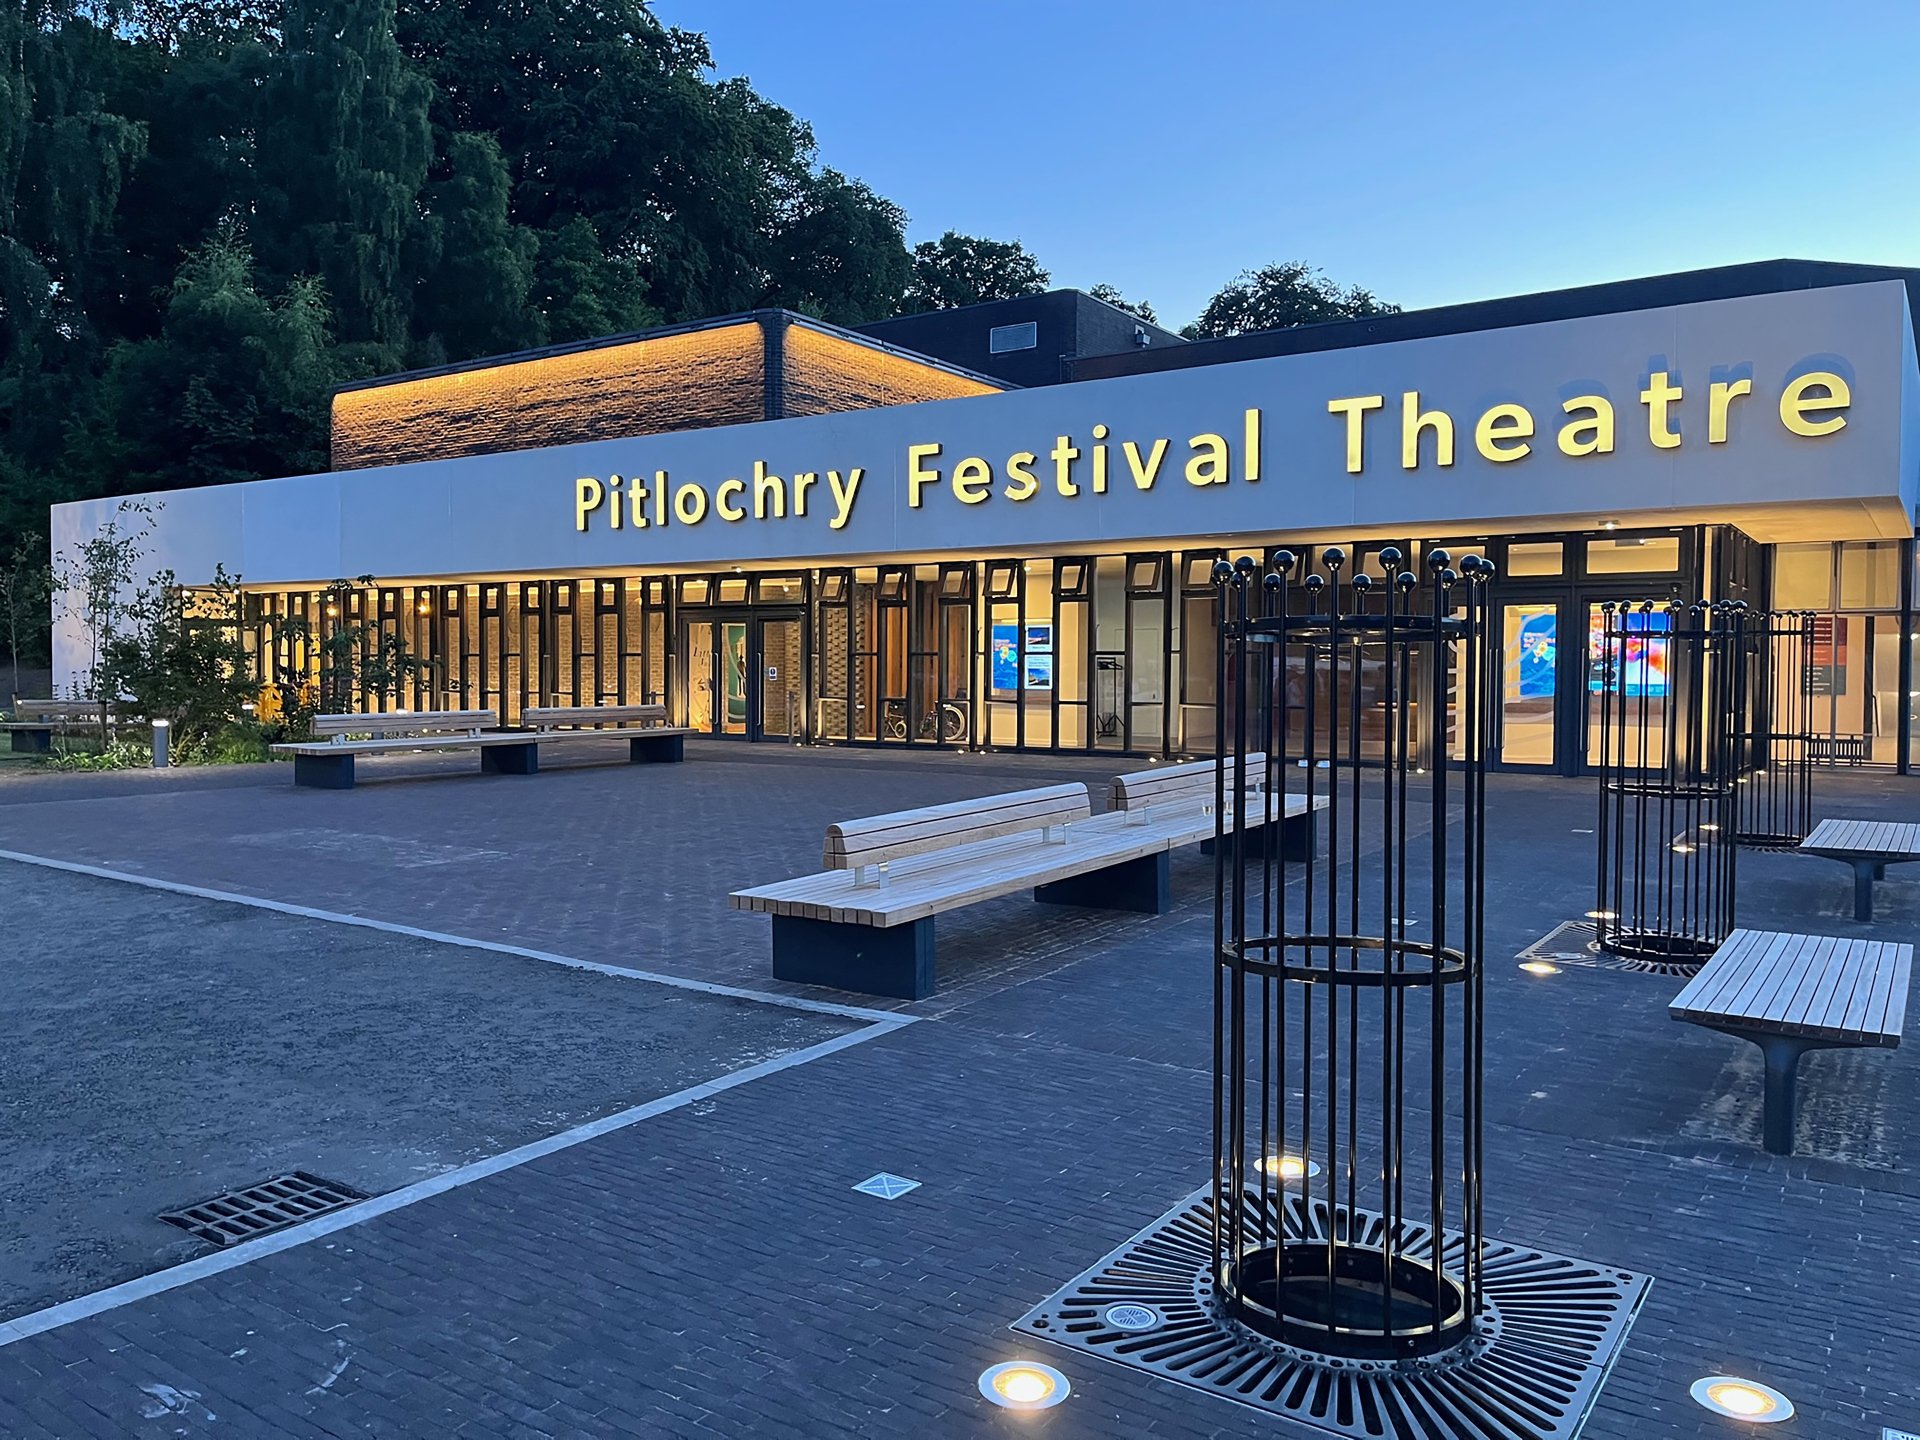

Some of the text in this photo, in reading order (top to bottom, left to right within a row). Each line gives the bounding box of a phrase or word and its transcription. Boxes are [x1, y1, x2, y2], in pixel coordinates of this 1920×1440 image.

[576, 371, 1852, 530] Pitlochry Festival Theatre
